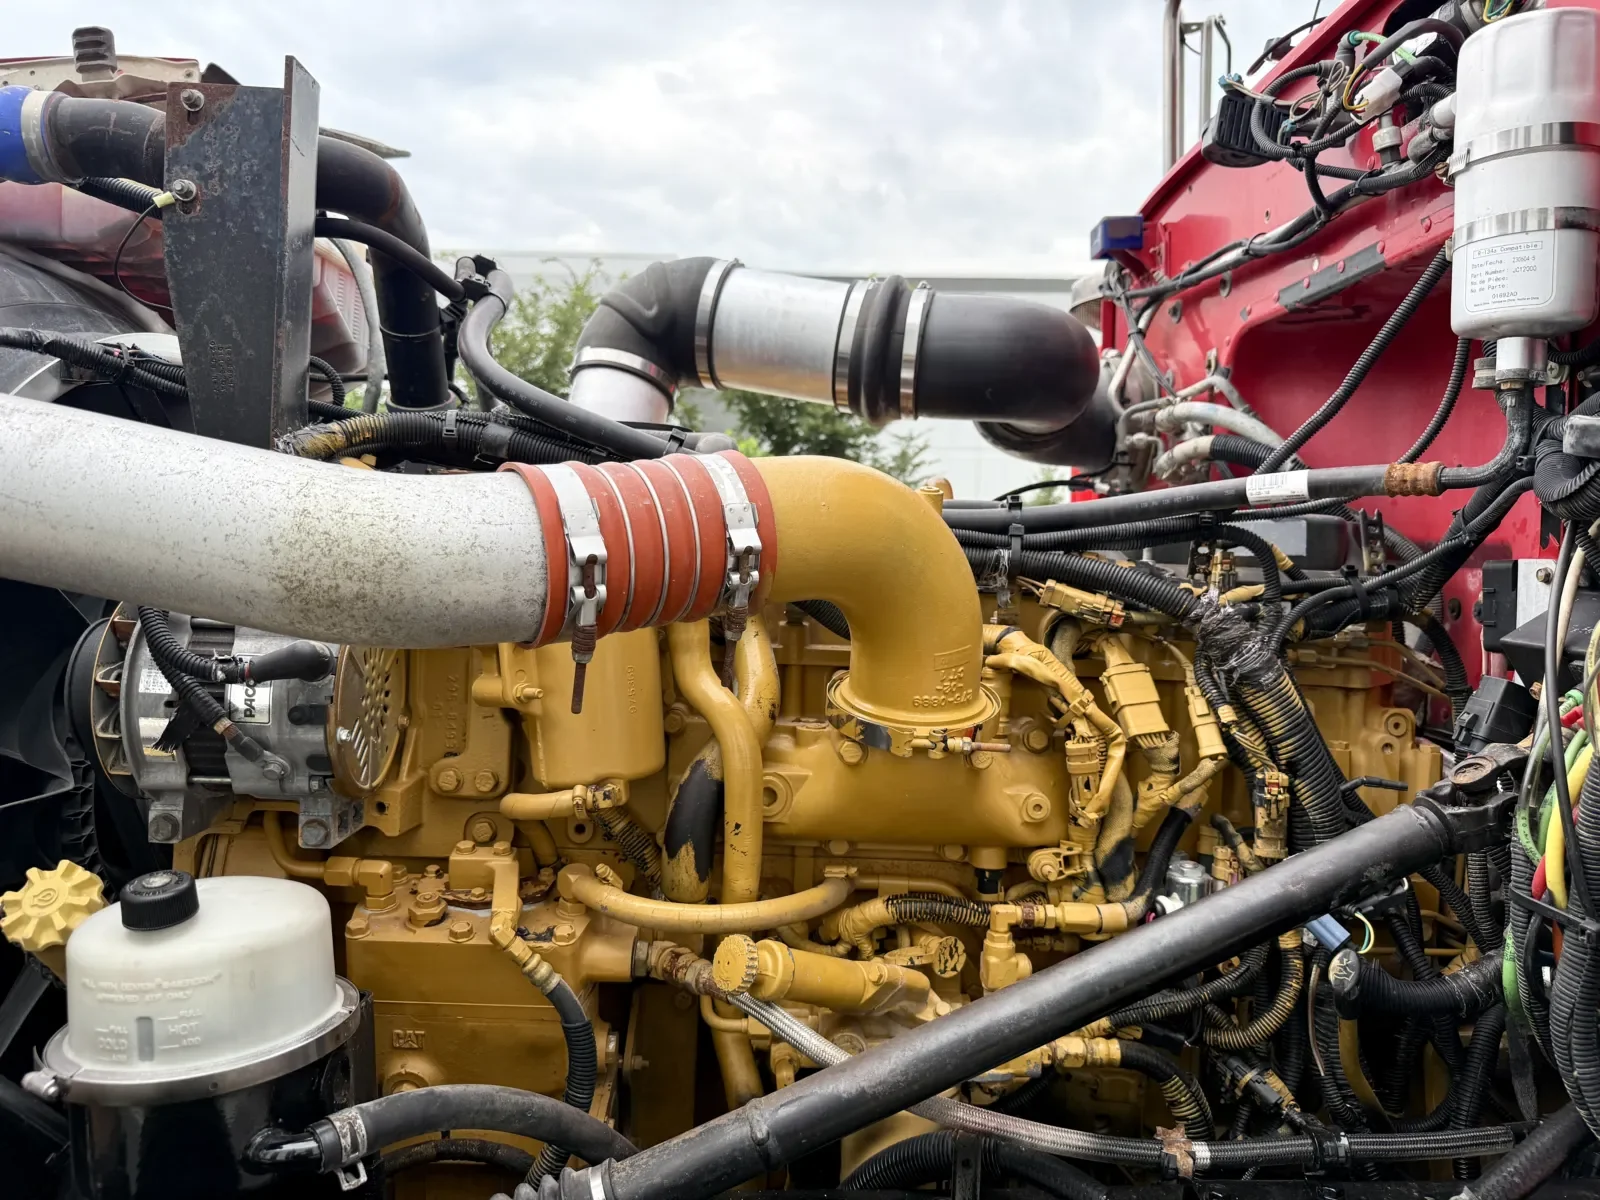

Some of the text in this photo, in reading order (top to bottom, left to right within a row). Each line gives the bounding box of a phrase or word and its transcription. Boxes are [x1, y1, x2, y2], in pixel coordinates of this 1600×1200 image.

[1500, 243, 1538, 252] Compatible
[168, 1021, 200, 1035] HOT
[99, 1037, 128, 1050] COLD
[182, 1036, 201, 1046] ADD
[393, 1029, 425, 1049] CAT
